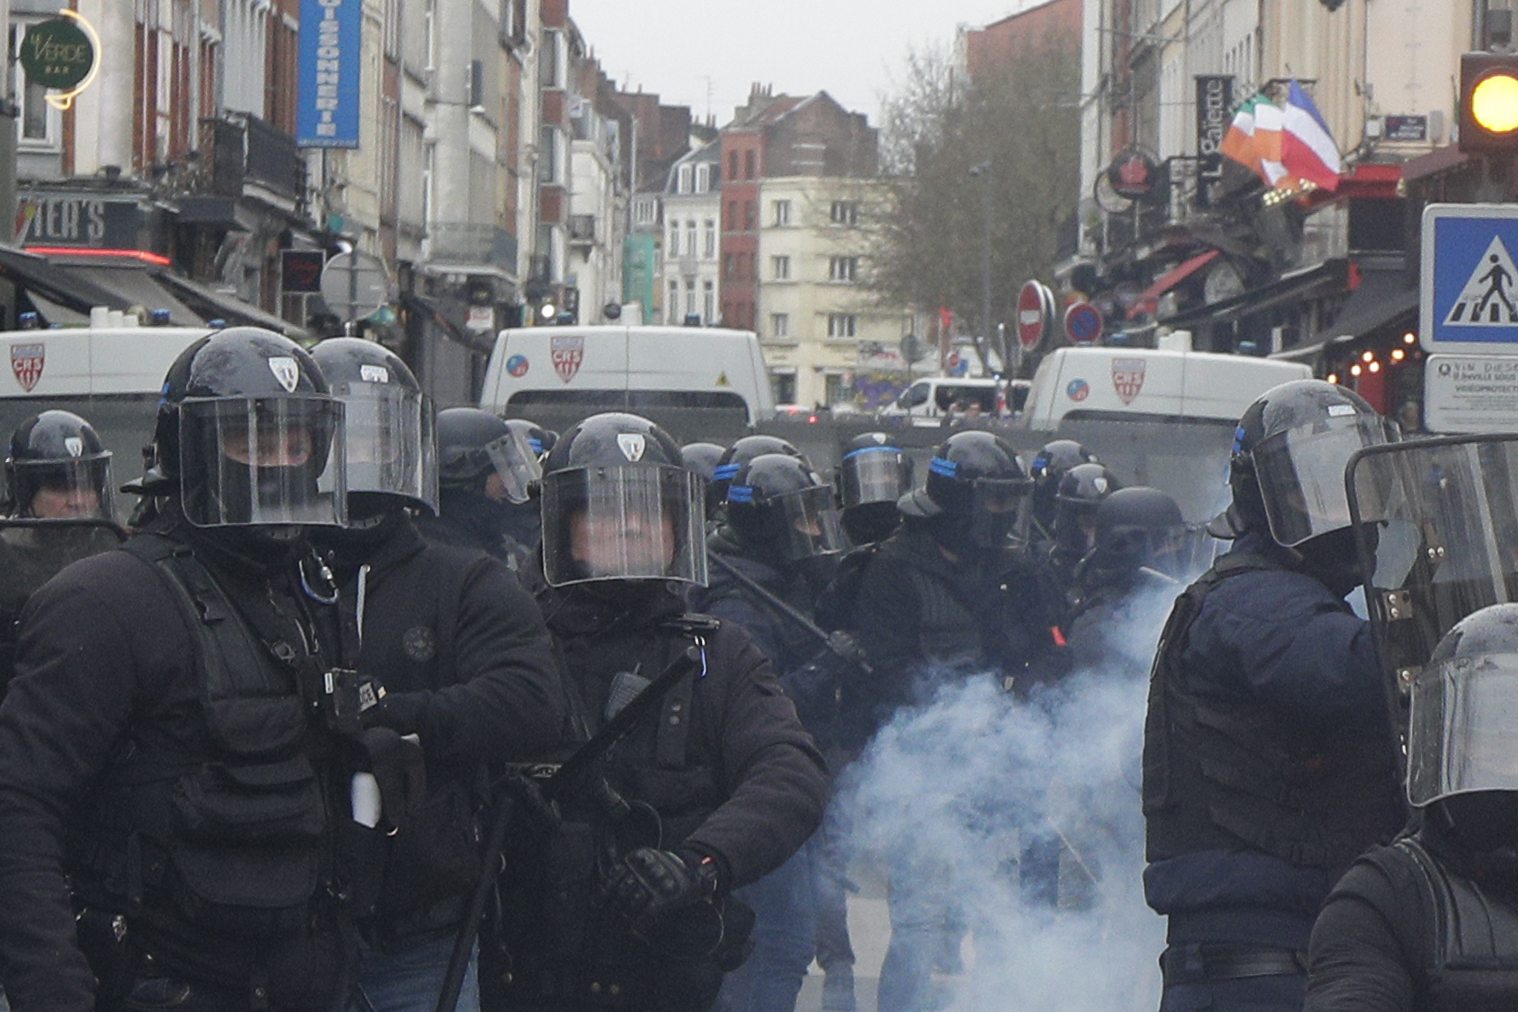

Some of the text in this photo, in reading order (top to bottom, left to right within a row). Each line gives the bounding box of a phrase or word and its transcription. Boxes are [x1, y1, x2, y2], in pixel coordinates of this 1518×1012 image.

[45, 65, 69, 74] BAR
[33, 197, 106, 241] TER'S
[552, 350, 581, 363] CRS
[13, 358, 42, 371] CRS
[1114, 371, 1142, 385] CRS
